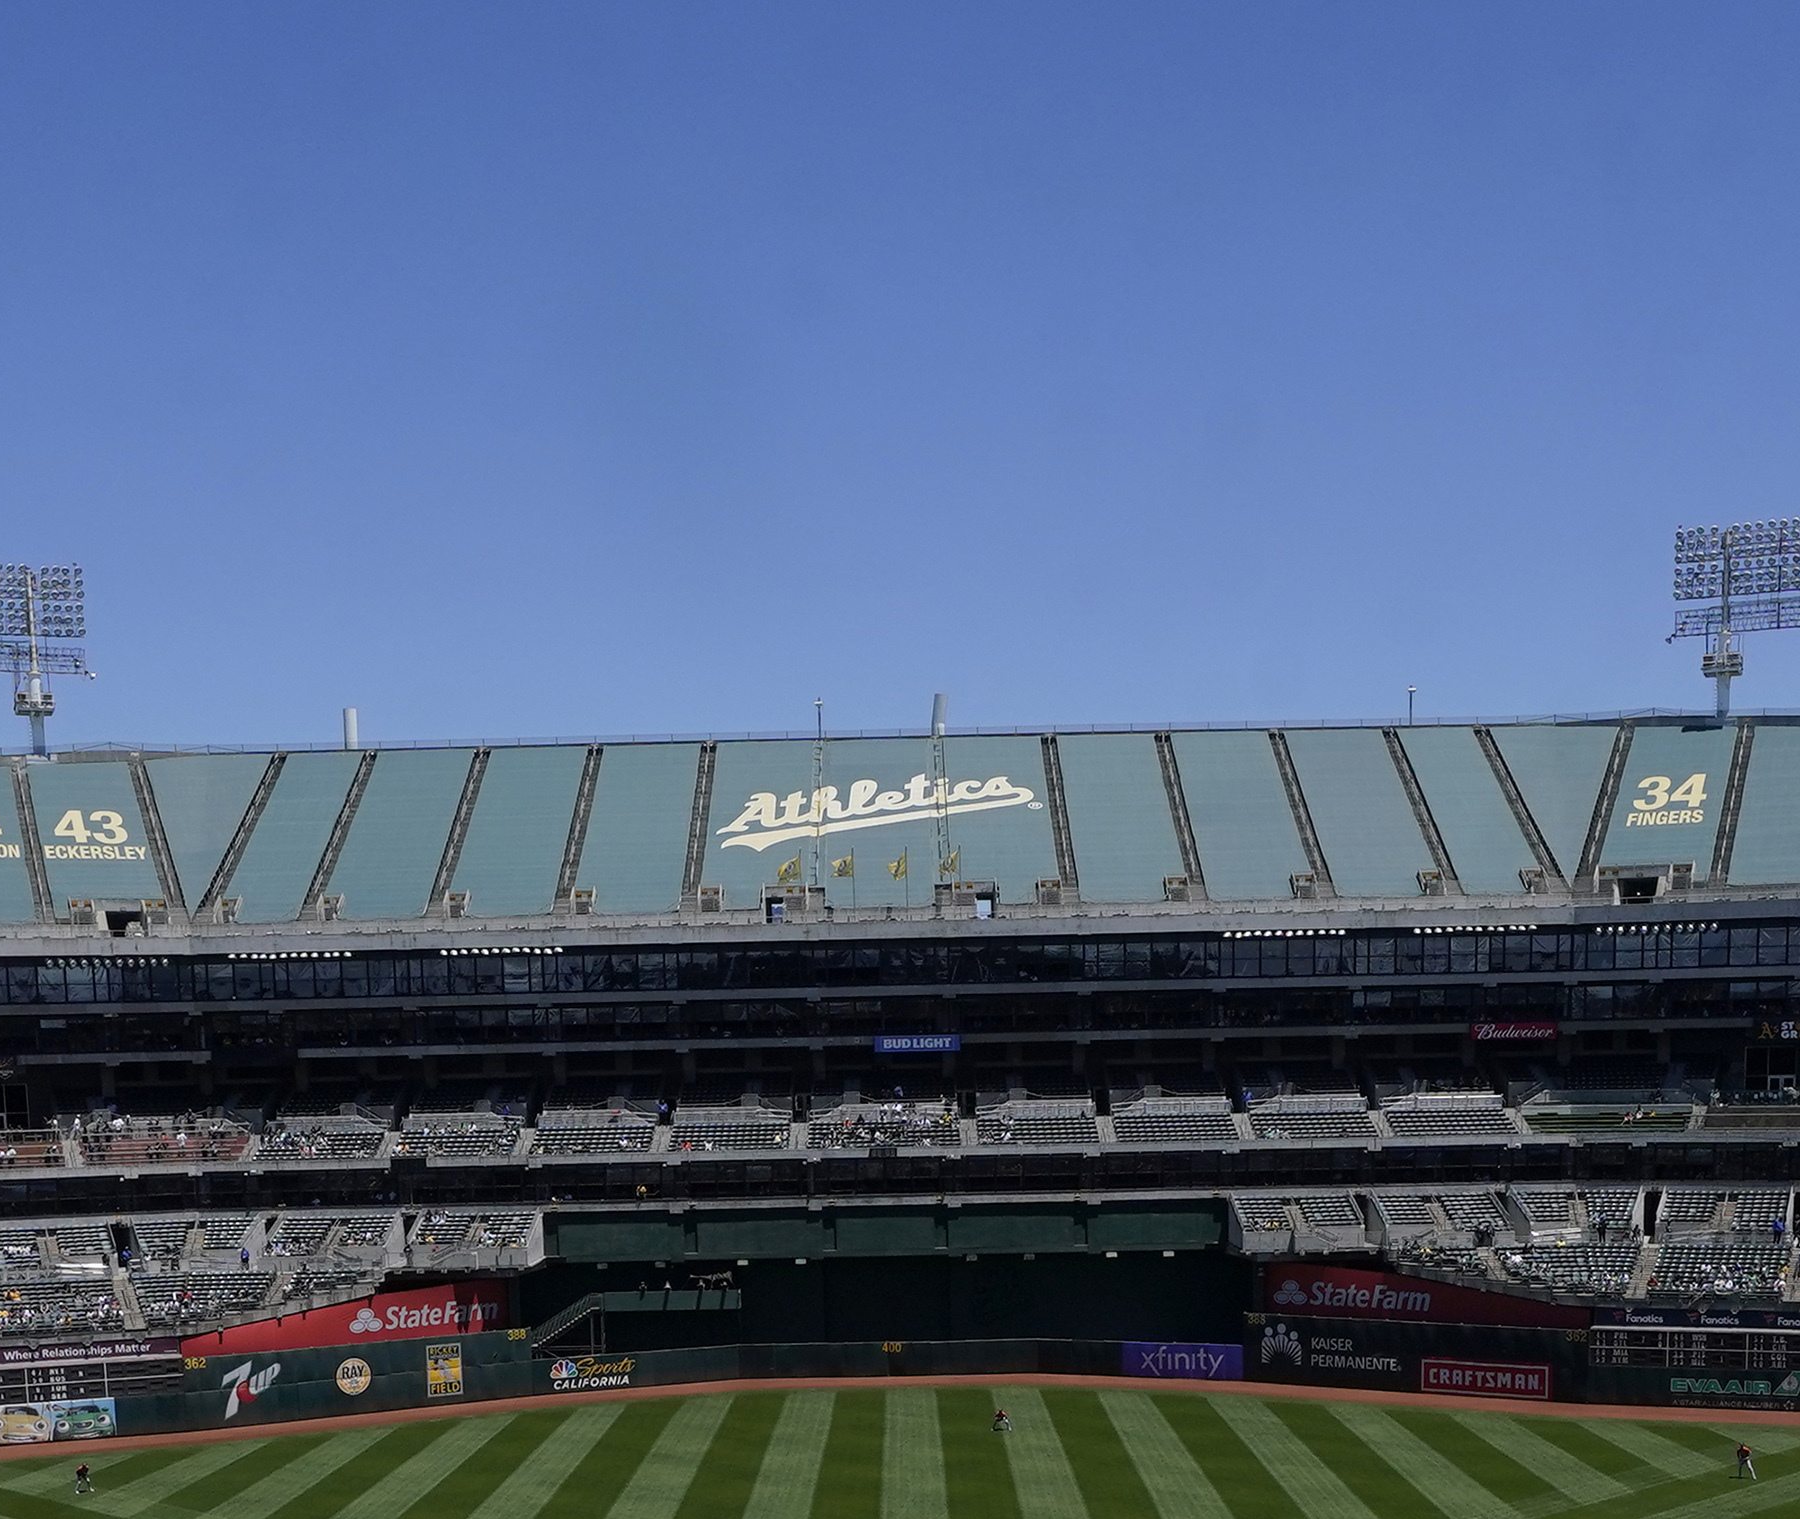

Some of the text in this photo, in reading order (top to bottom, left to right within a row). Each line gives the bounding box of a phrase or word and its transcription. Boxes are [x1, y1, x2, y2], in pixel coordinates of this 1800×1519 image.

[1632, 773, 1708, 810] 34
[715, 773, 1030, 845] Athletics
[1625, 810, 1704, 827] FINGERS
[53, 810, 129, 845] 43
[44, 845, 147, 861] ECKERSLEY
[1474, 1022, 1554, 1040] Budweiser
[883, 1037, 951, 1050] BUD LIGHT
[1625, 1314, 1664, 1324] Fanatics
[507, 1329, 527, 1341] 388
[4, 1349, 39, 1362] Where
[42, 1344, 112, 1360] Relationships
[115, 1342, 151, 1353] Matter
[429, 1345, 458, 1356] RICKEY
[881, 1342, 902, 1353] 400
[1311, 1337, 1353, 1351] KAISER
[184, 1357, 206, 1370] 362
[1141, 1343, 1225, 1376] xfinity
[1310, 1355, 1398, 1372] PERMANENTE
[342, 1365, 364, 1379] RAY
[576, 1357, 636, 1383] Sports
[552, 1374, 630, 1390] CALIFORNIA
[1428, 1368, 1540, 1390] CRAFTSMAN
[429, 1382, 460, 1395] FIELD
